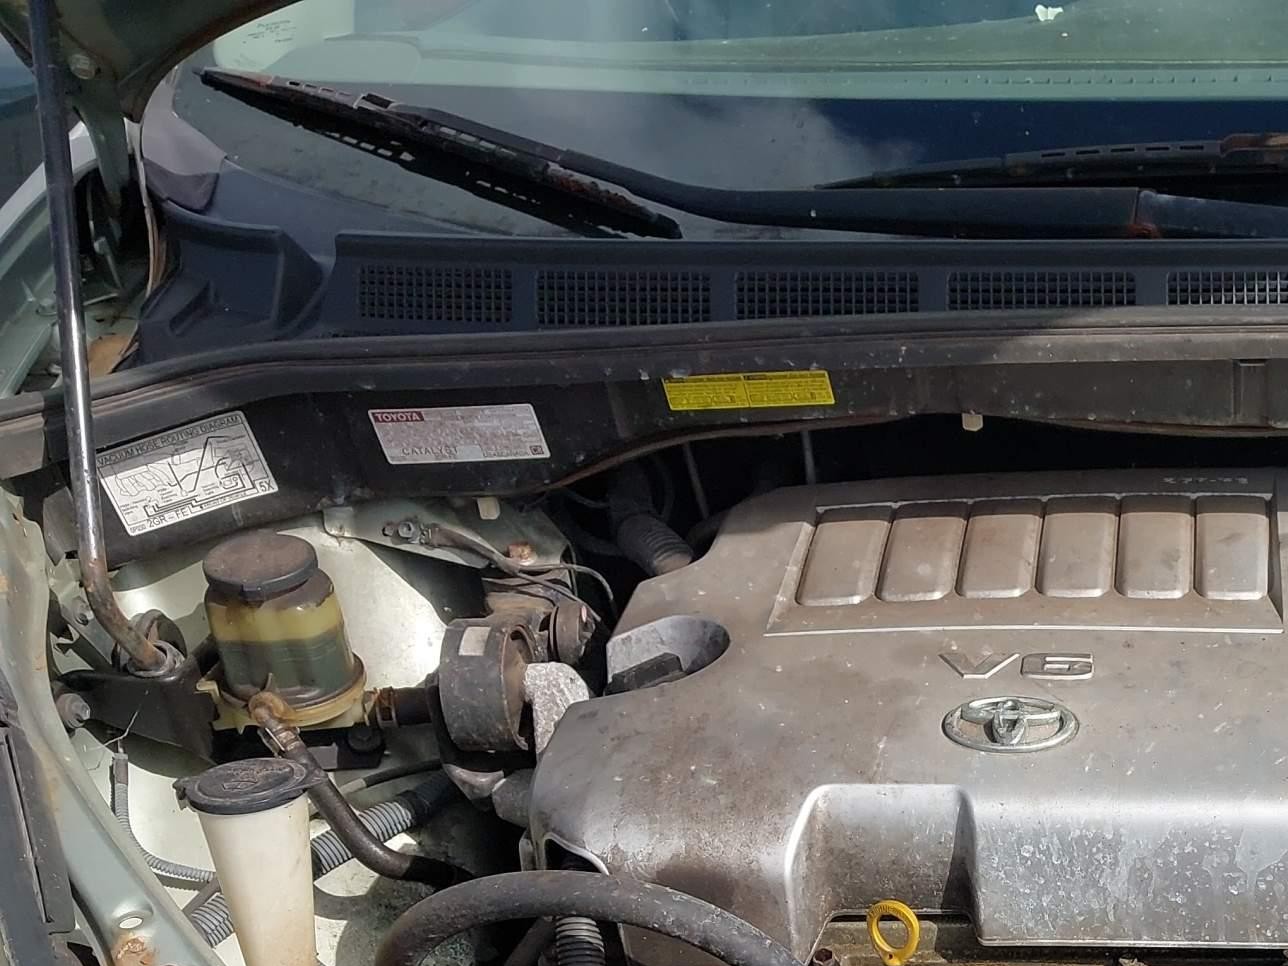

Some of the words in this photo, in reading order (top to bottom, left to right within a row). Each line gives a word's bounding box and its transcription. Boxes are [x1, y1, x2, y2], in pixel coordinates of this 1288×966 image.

[374, 412, 421, 422] TOYOTA
[97, 446, 134, 467] VACUUM
[134, 440, 160, 455] HOSE
[160, 427, 199, 446] ROUTING
[200, 415, 240, 434] DIAGRAM
[259, 479, 276, 493] 5X
[938, 652, 1095, 681] V6
